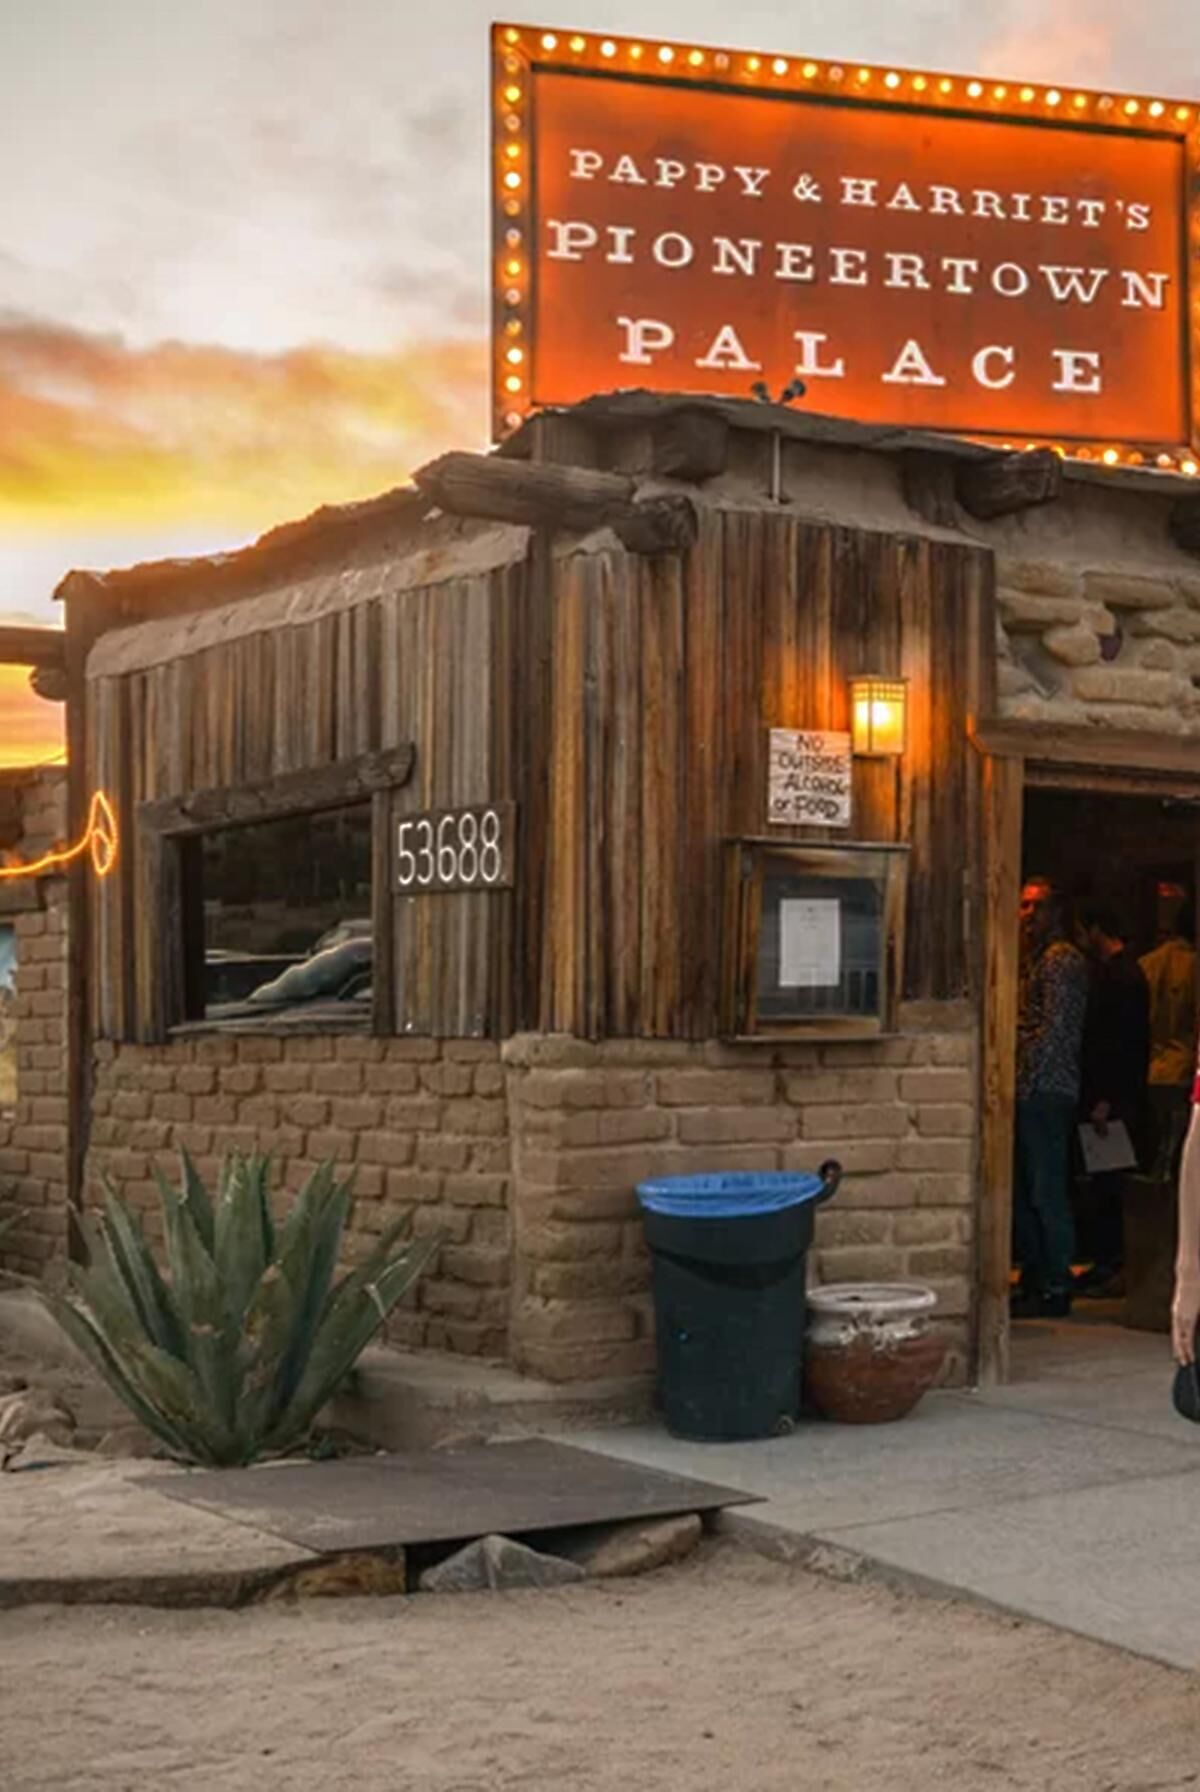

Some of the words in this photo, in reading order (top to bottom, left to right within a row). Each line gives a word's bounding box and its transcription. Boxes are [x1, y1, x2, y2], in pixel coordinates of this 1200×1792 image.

[569, 148, 771, 196] PAPPY
[792, 172, 822, 203] &
[839, 176, 1151, 231] HARRIET'S
[546, 218, 1169, 308] PIONEERTOWN
[616, 316, 1101, 393] PALACE
[398, 808, 502, 886] 53688
